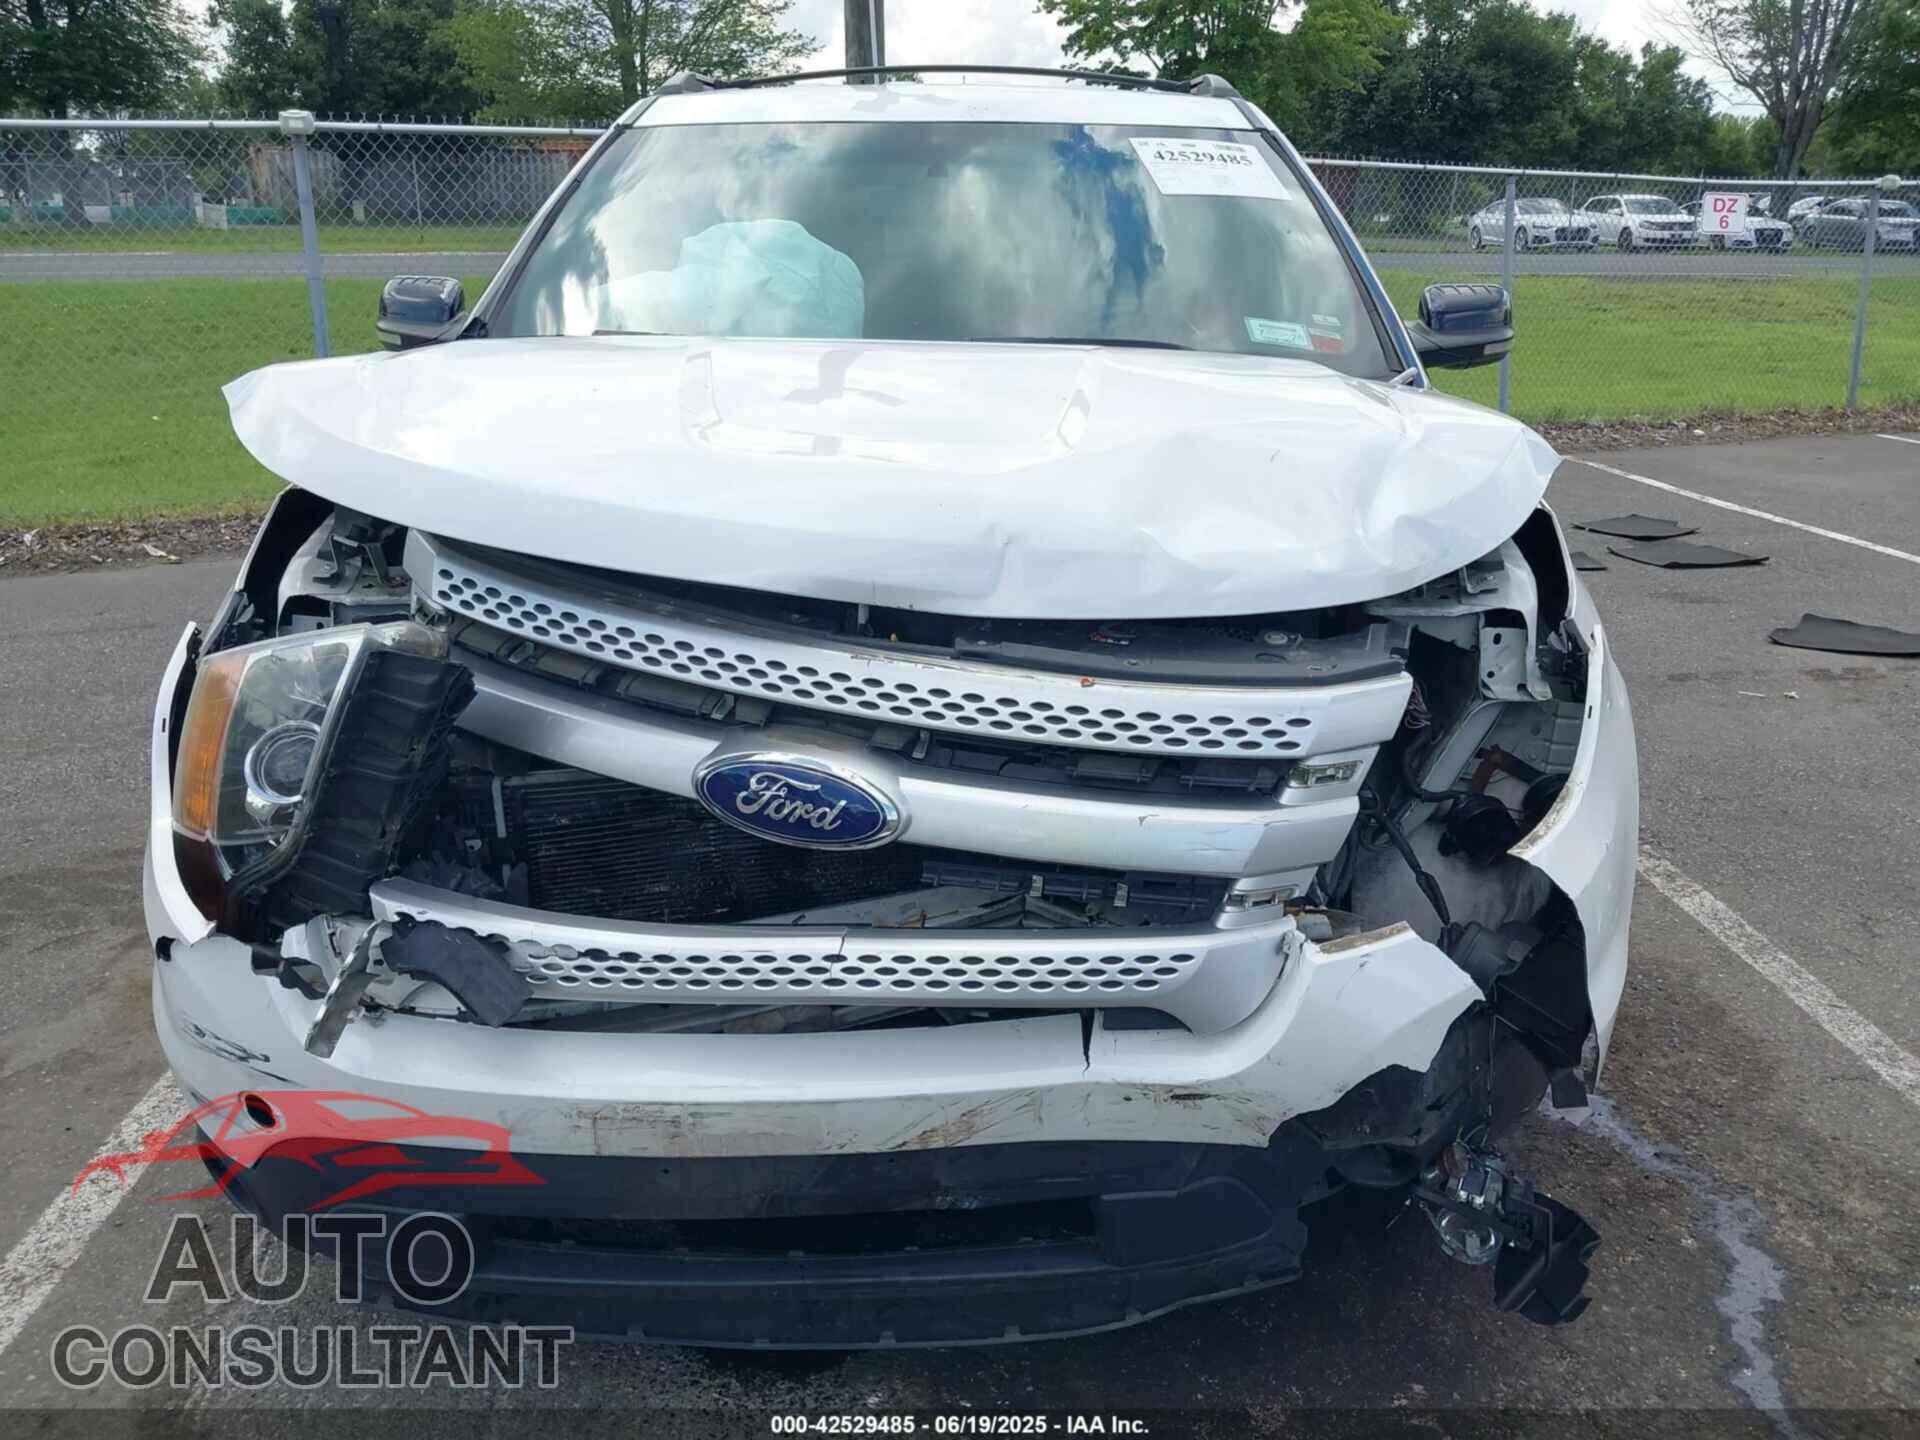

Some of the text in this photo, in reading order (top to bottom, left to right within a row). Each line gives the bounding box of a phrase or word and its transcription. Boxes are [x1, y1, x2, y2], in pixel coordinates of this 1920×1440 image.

[1153, 150, 1254, 166] 42529485
[1713, 198, 1738, 213] DZ
[1719, 215, 1729, 230] 6
[735, 772, 848, 831] Ford
